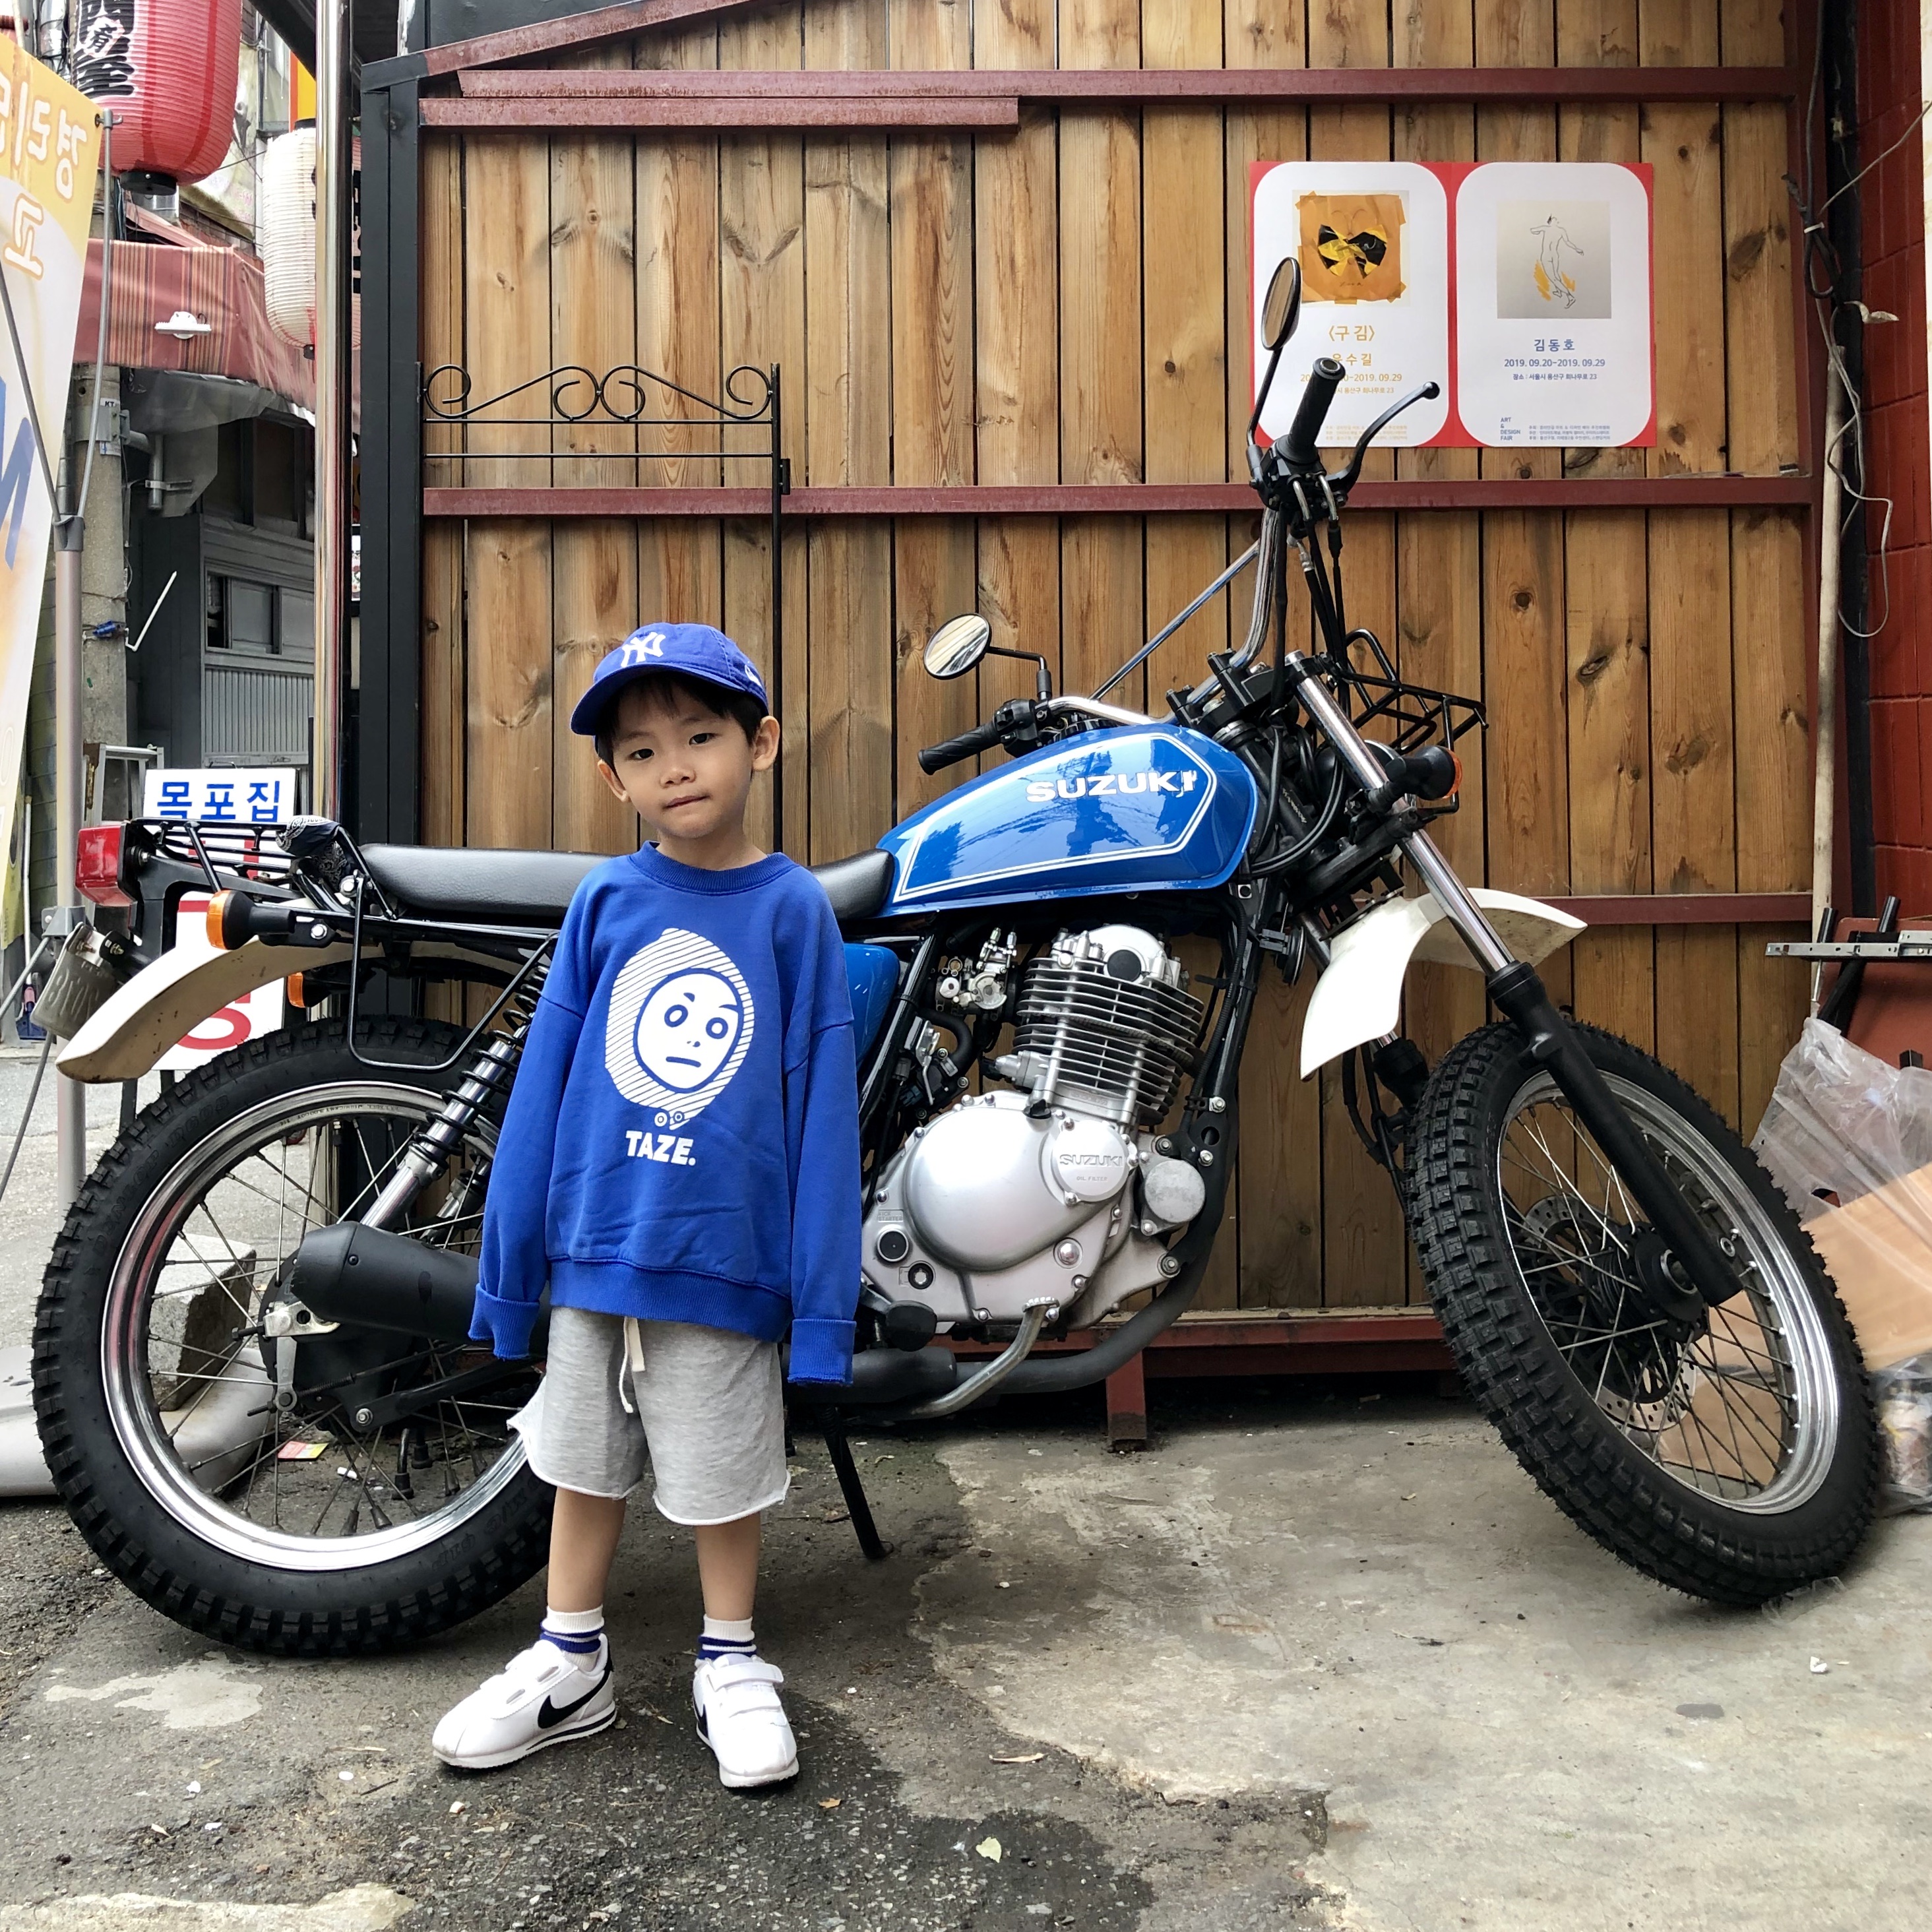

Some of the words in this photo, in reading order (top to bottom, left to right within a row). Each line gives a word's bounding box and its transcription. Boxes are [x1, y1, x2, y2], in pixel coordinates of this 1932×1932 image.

[1504, 359, 1528, 367] 2019.
[1582, 359, 1605, 367] 09.29
[1379, 373, 1402, 382] 09.29
[1025, 770, 1197, 803] SUZUKI
[156, 780, 280, 823] 목포집
[625, 1129, 697, 1166] TAZE.
[1059, 1154, 1123, 1167] SUZUKI
